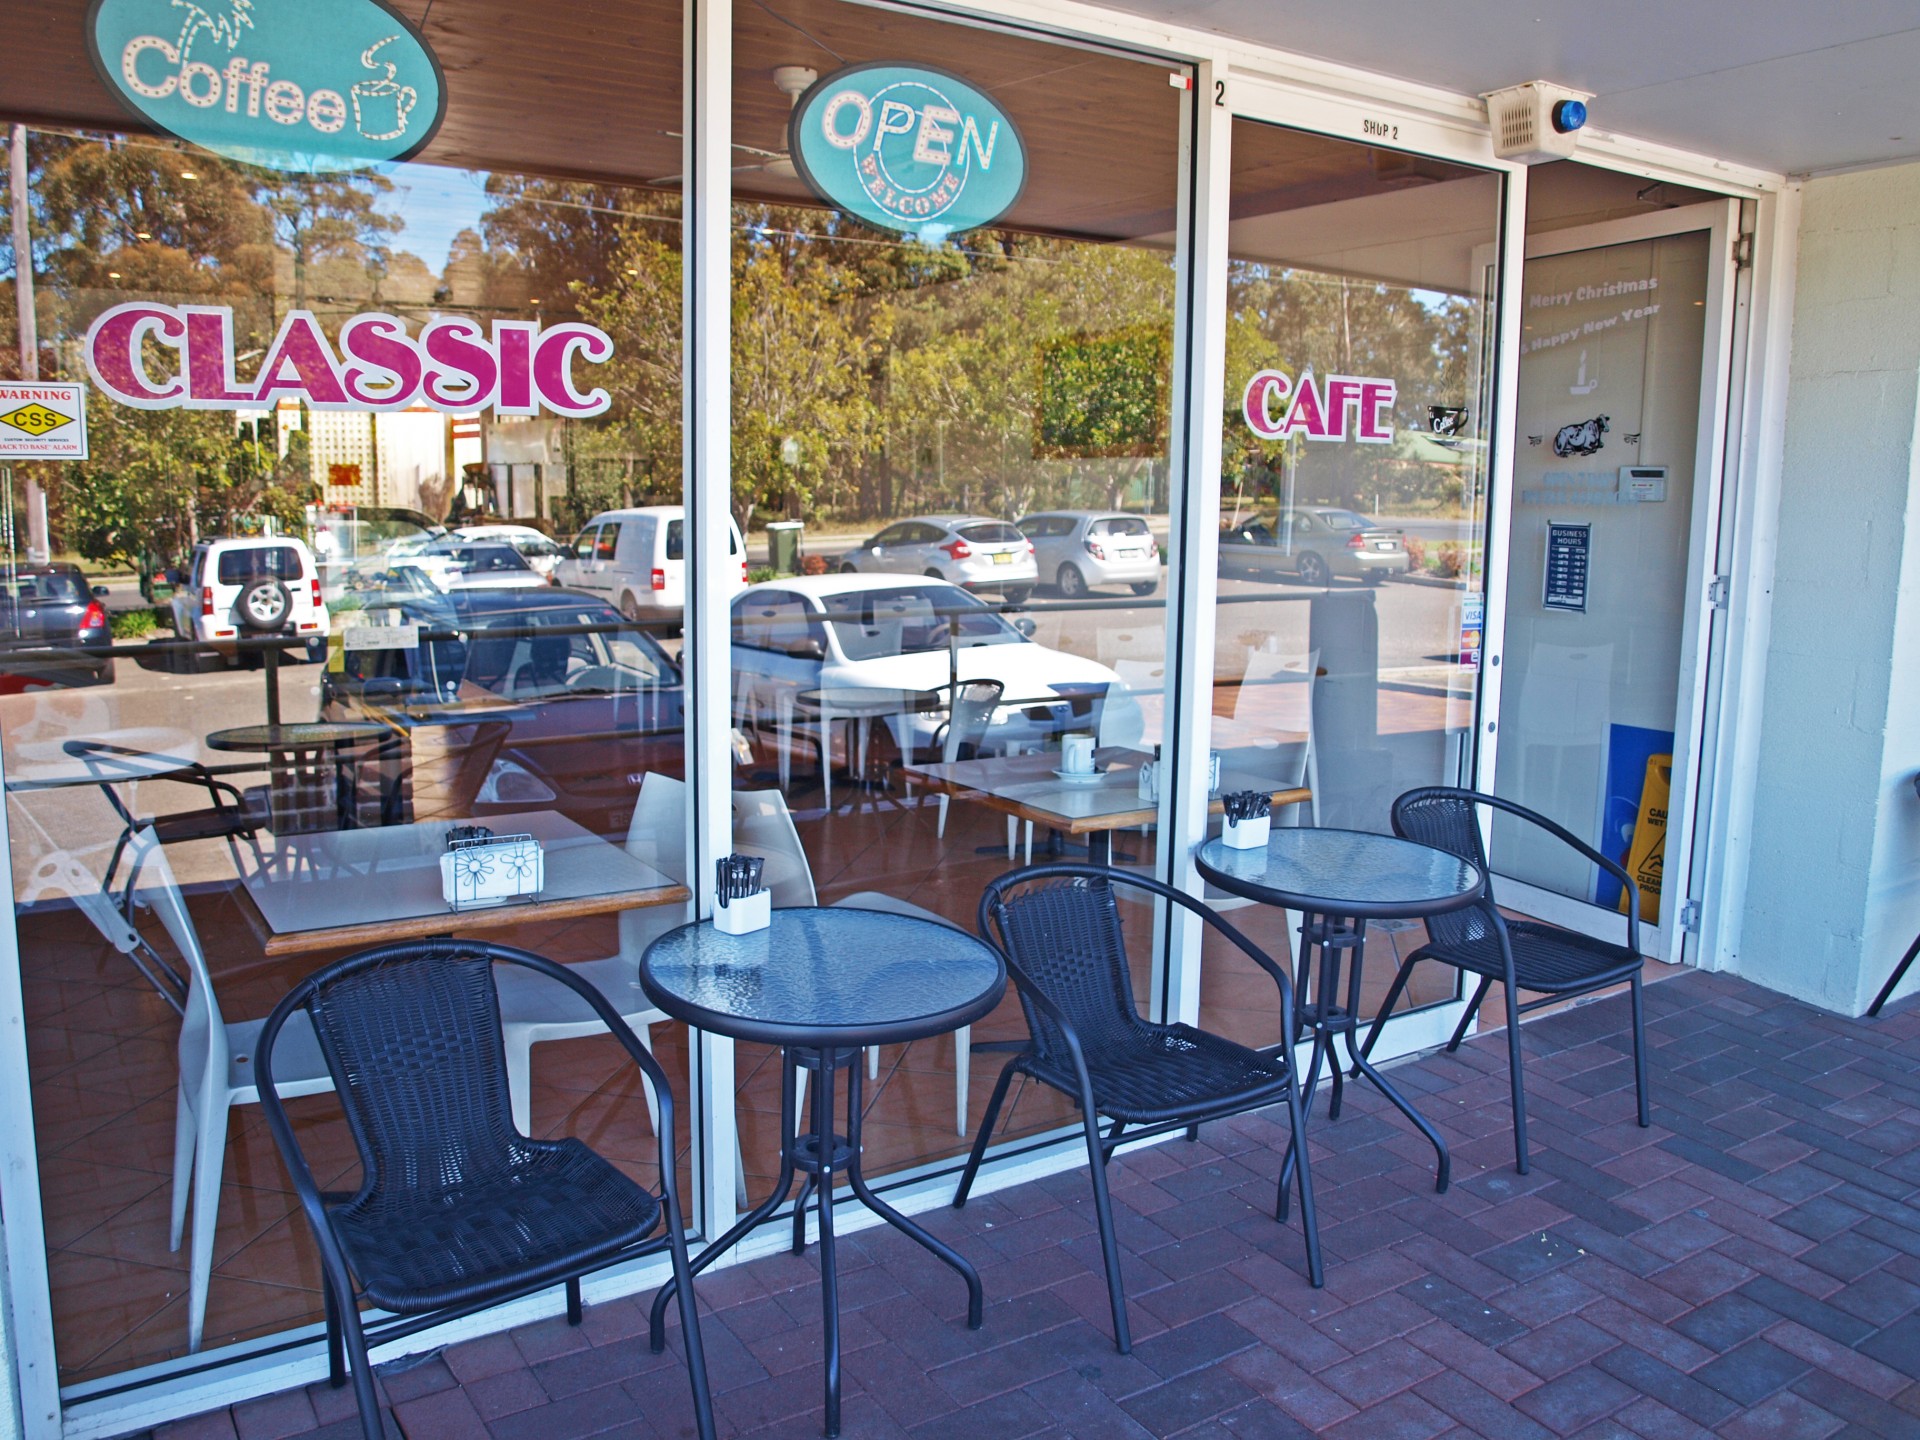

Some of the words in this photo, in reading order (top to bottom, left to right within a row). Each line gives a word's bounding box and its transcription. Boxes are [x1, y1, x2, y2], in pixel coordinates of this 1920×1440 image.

[122, 35, 347, 133] Coffee
[1215, 80, 1225, 107] 2
[823, 91, 999, 171] OPEN
[1393, 126, 1398, 140] 2
[861, 153, 960, 215] WELCOME
[1530, 291, 1573, 307] Merry
[1576, 278, 1658, 301] Christmas
[1531, 328, 1579, 351] Happy
[1583, 316, 1618, 334] New
[1621, 304, 1660, 321] Year
[85, 302, 614, 418] CLASSIC
[0, 390, 71, 400] WARNING
[1243, 369, 1397, 443] CAFE
[14, 412, 57, 426] CSS
[1465, 611, 1482, 620] VISA
